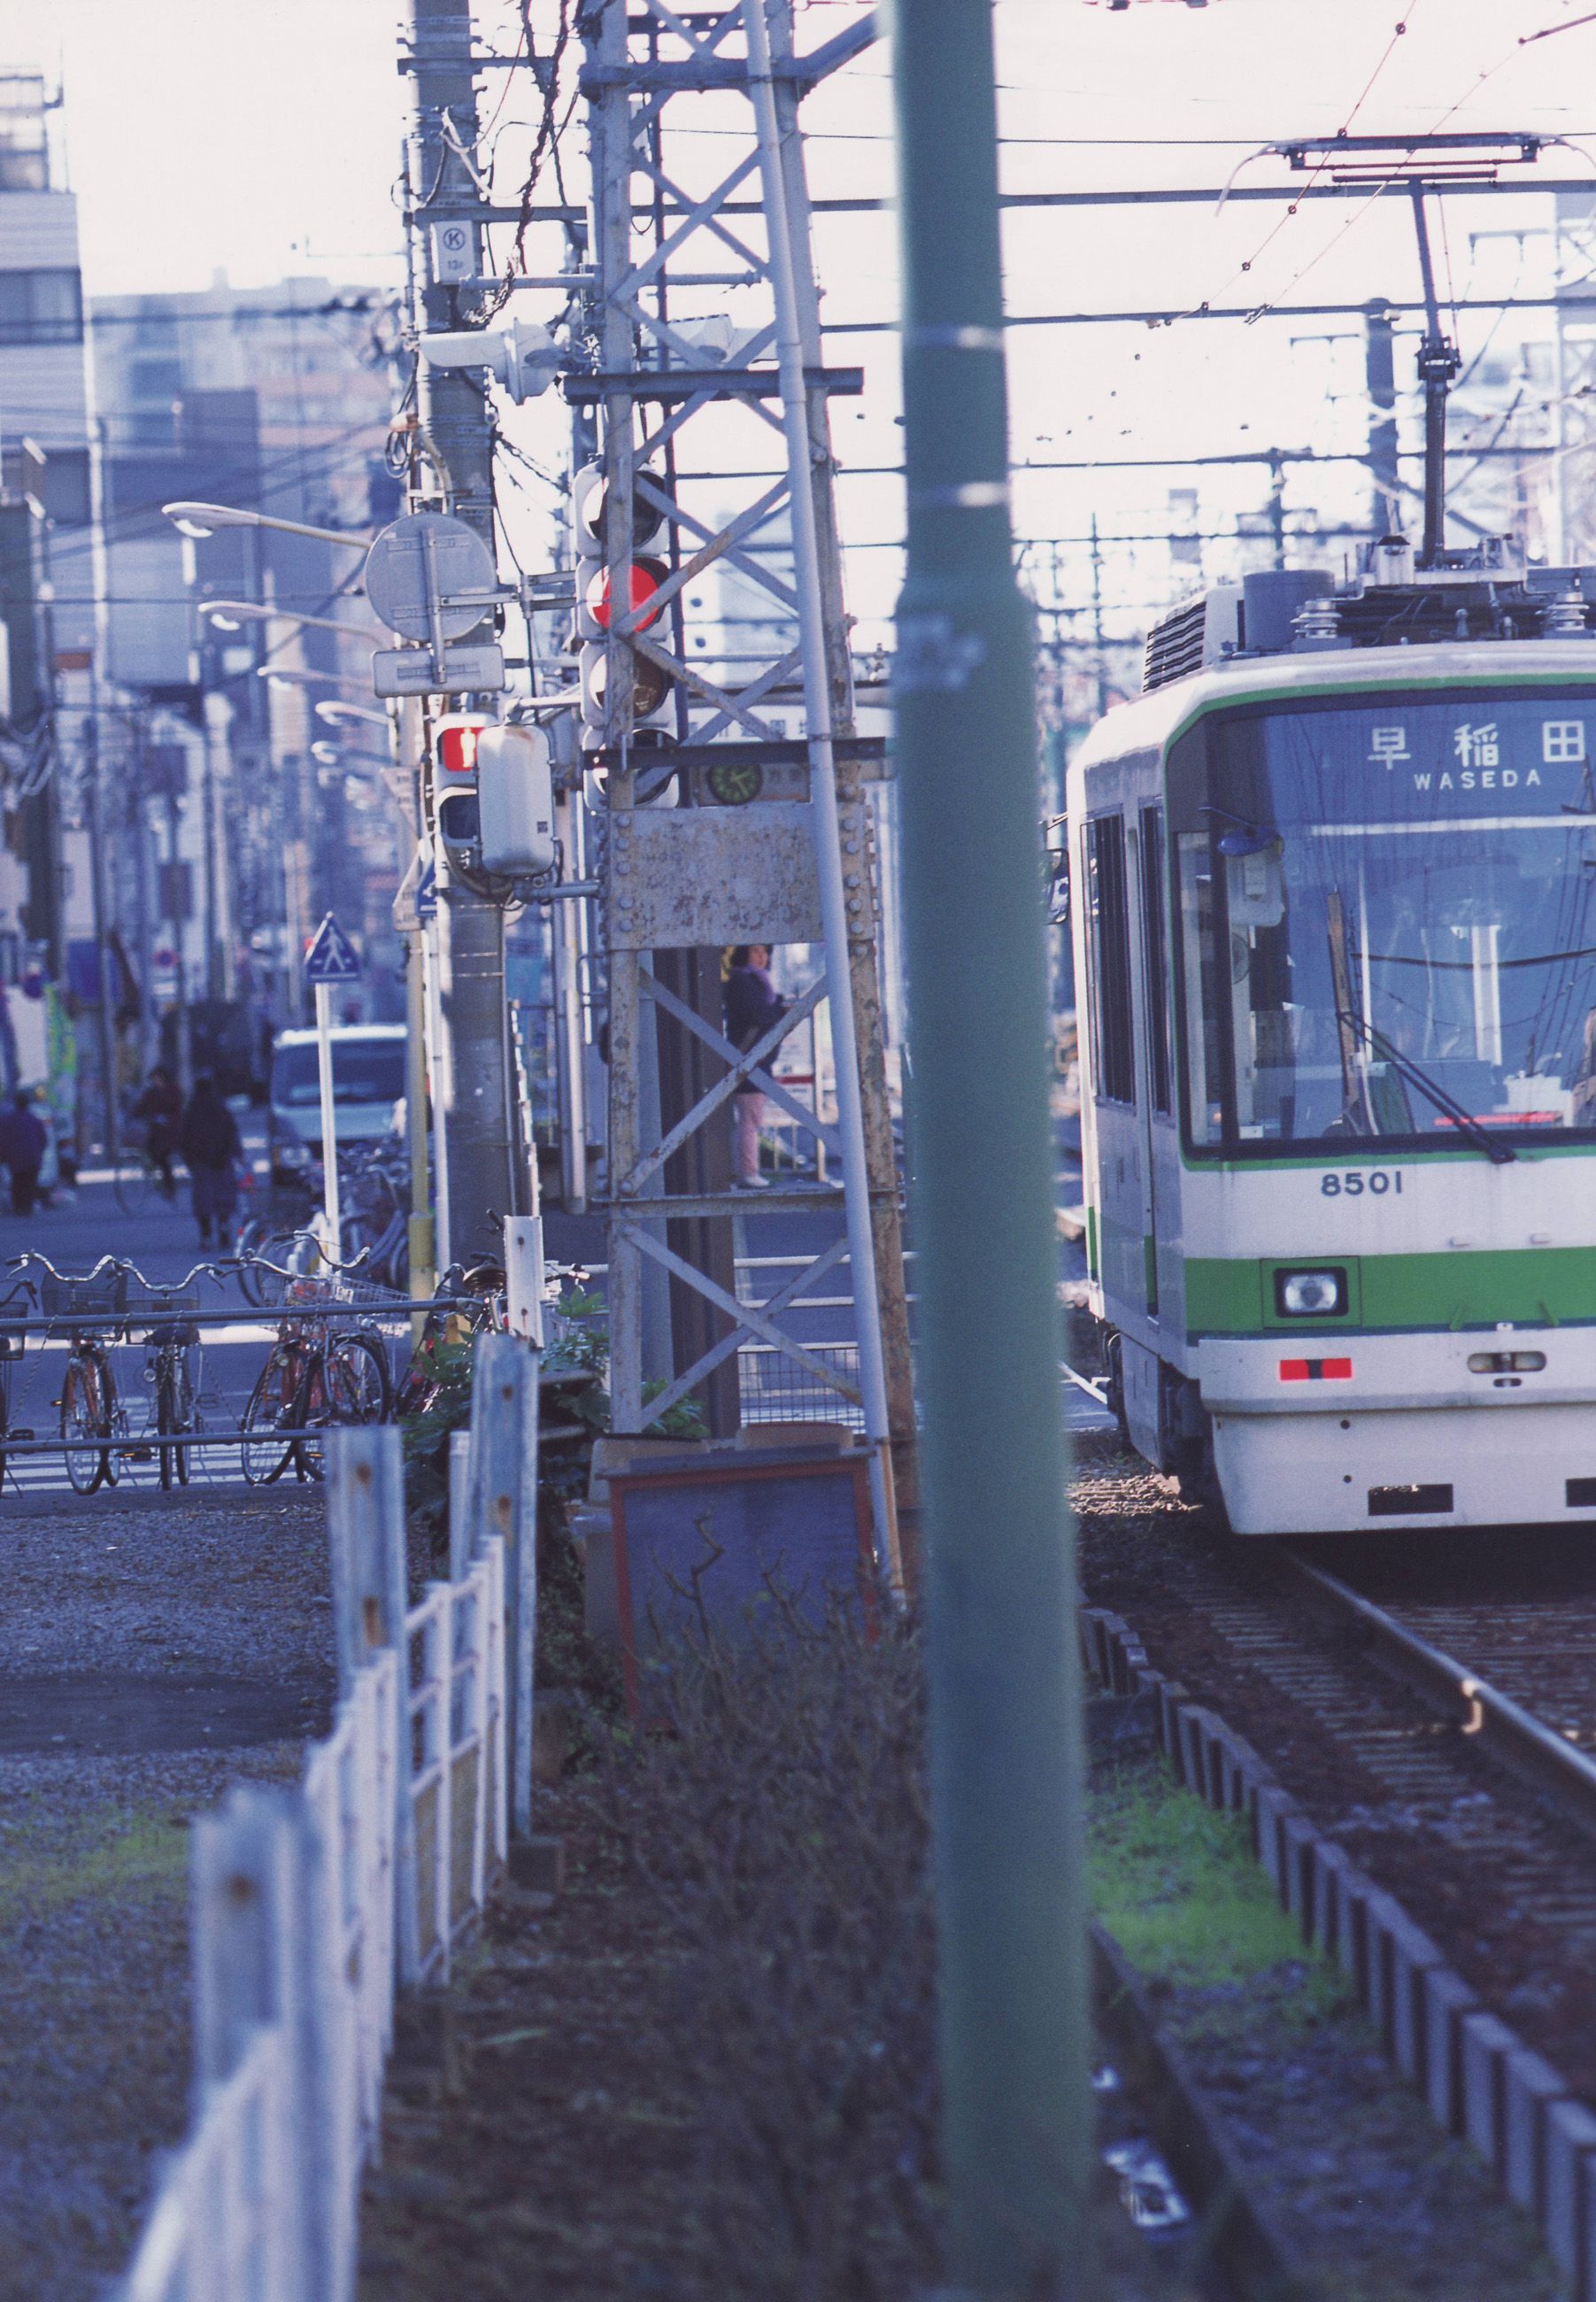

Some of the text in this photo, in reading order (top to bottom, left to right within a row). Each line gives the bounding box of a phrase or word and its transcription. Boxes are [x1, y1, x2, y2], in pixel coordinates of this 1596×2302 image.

[1367, 721, 1585, 770] 早稲田
[1414, 769, 1541, 790] WASEDA
[1321, 1170, 1402, 1197] 8501
